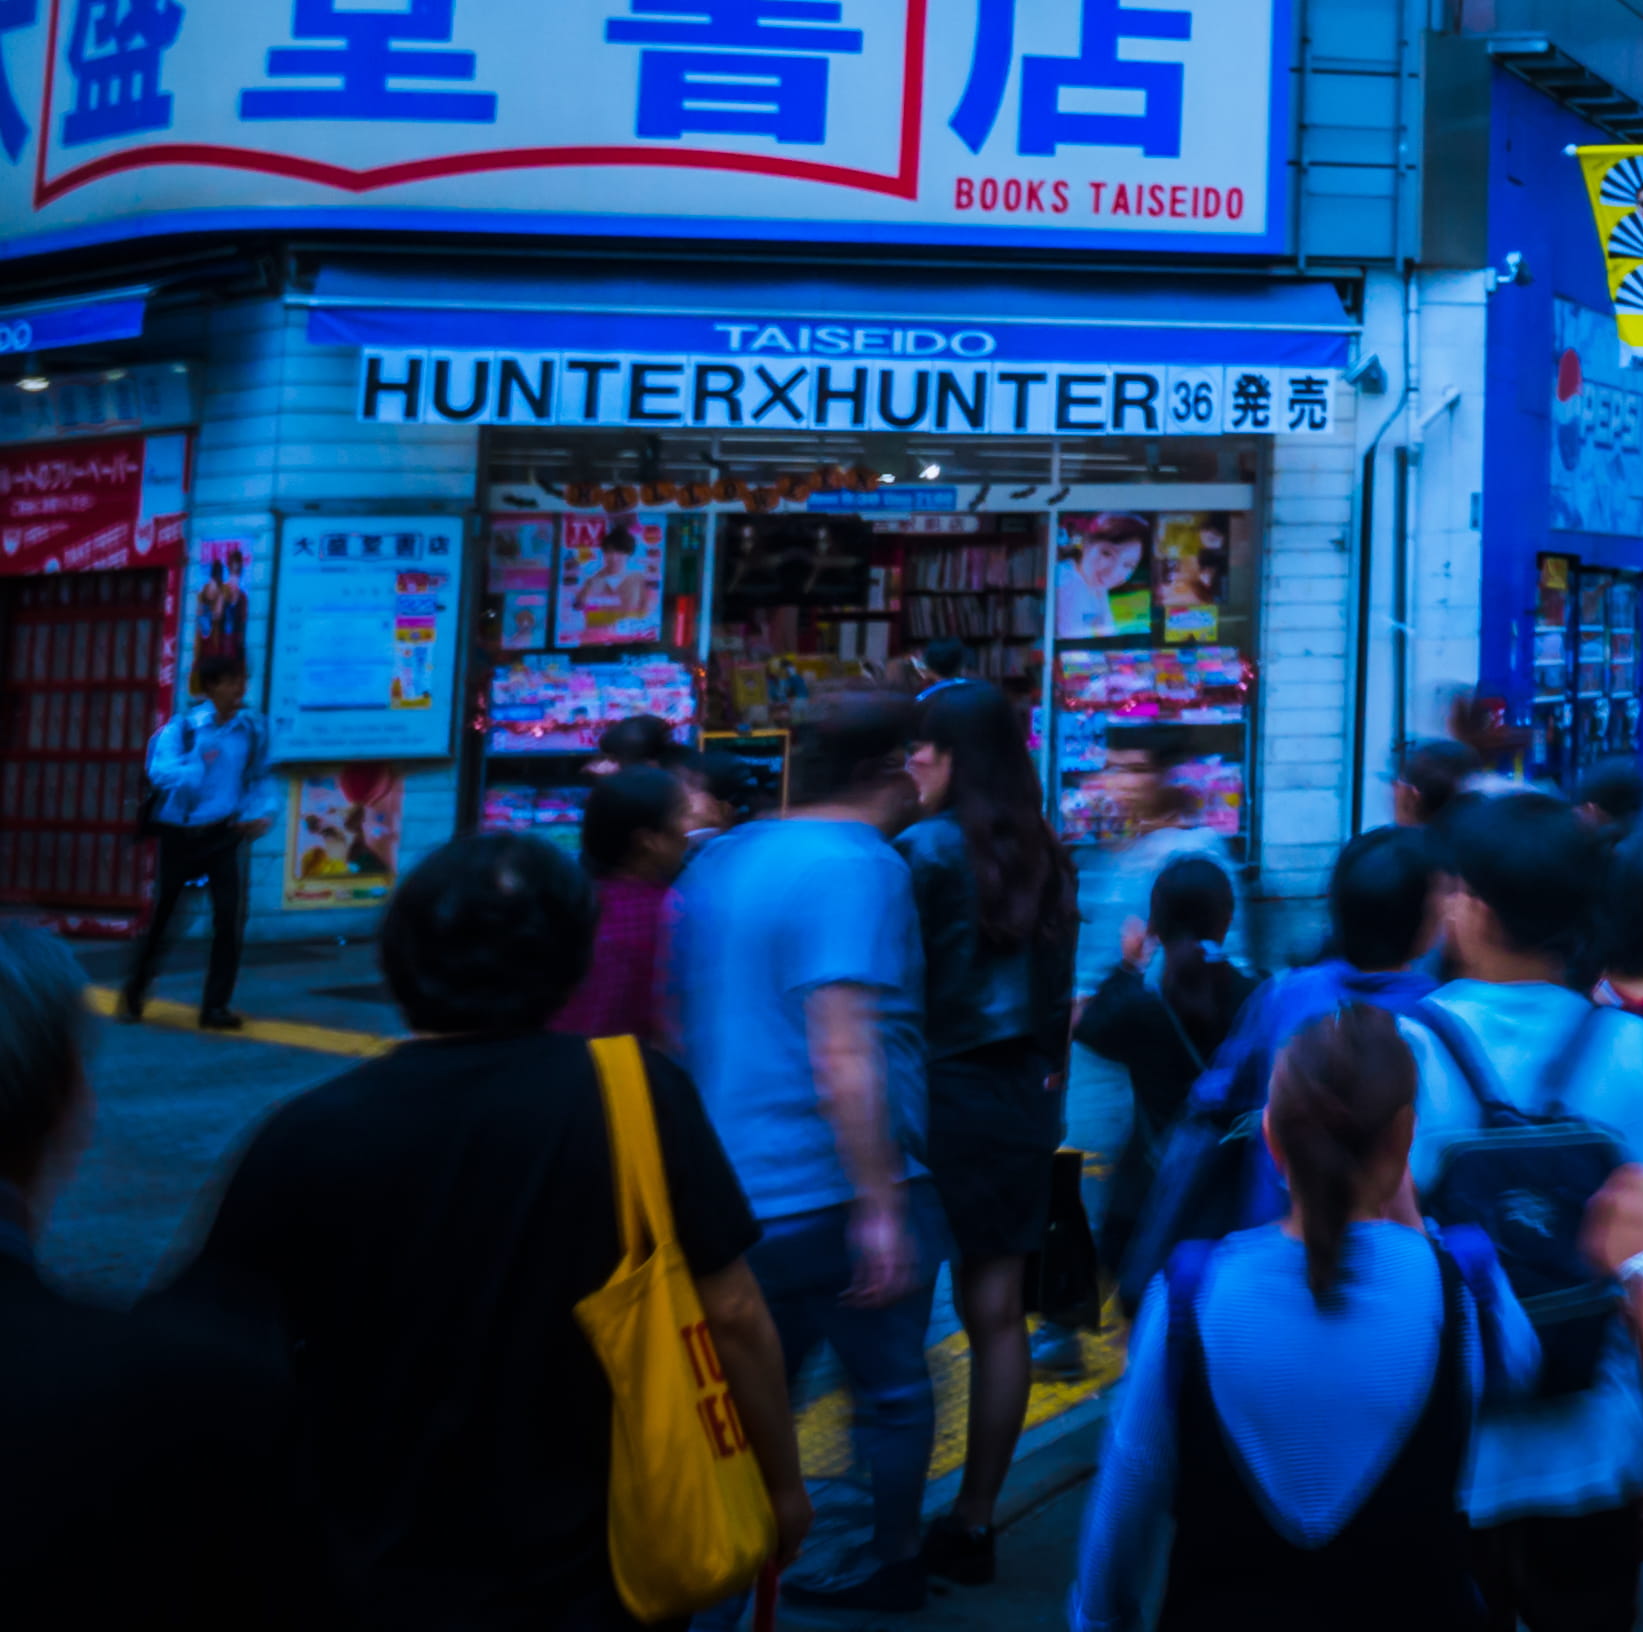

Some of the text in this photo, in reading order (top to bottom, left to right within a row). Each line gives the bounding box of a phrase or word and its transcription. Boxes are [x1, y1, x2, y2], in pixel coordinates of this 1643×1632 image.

[955, 177, 1245, 221] BOOKS TAISEIDO
[714, 324, 997, 358] TAISEIDO
[1231, 373, 1329, 434] 発売
